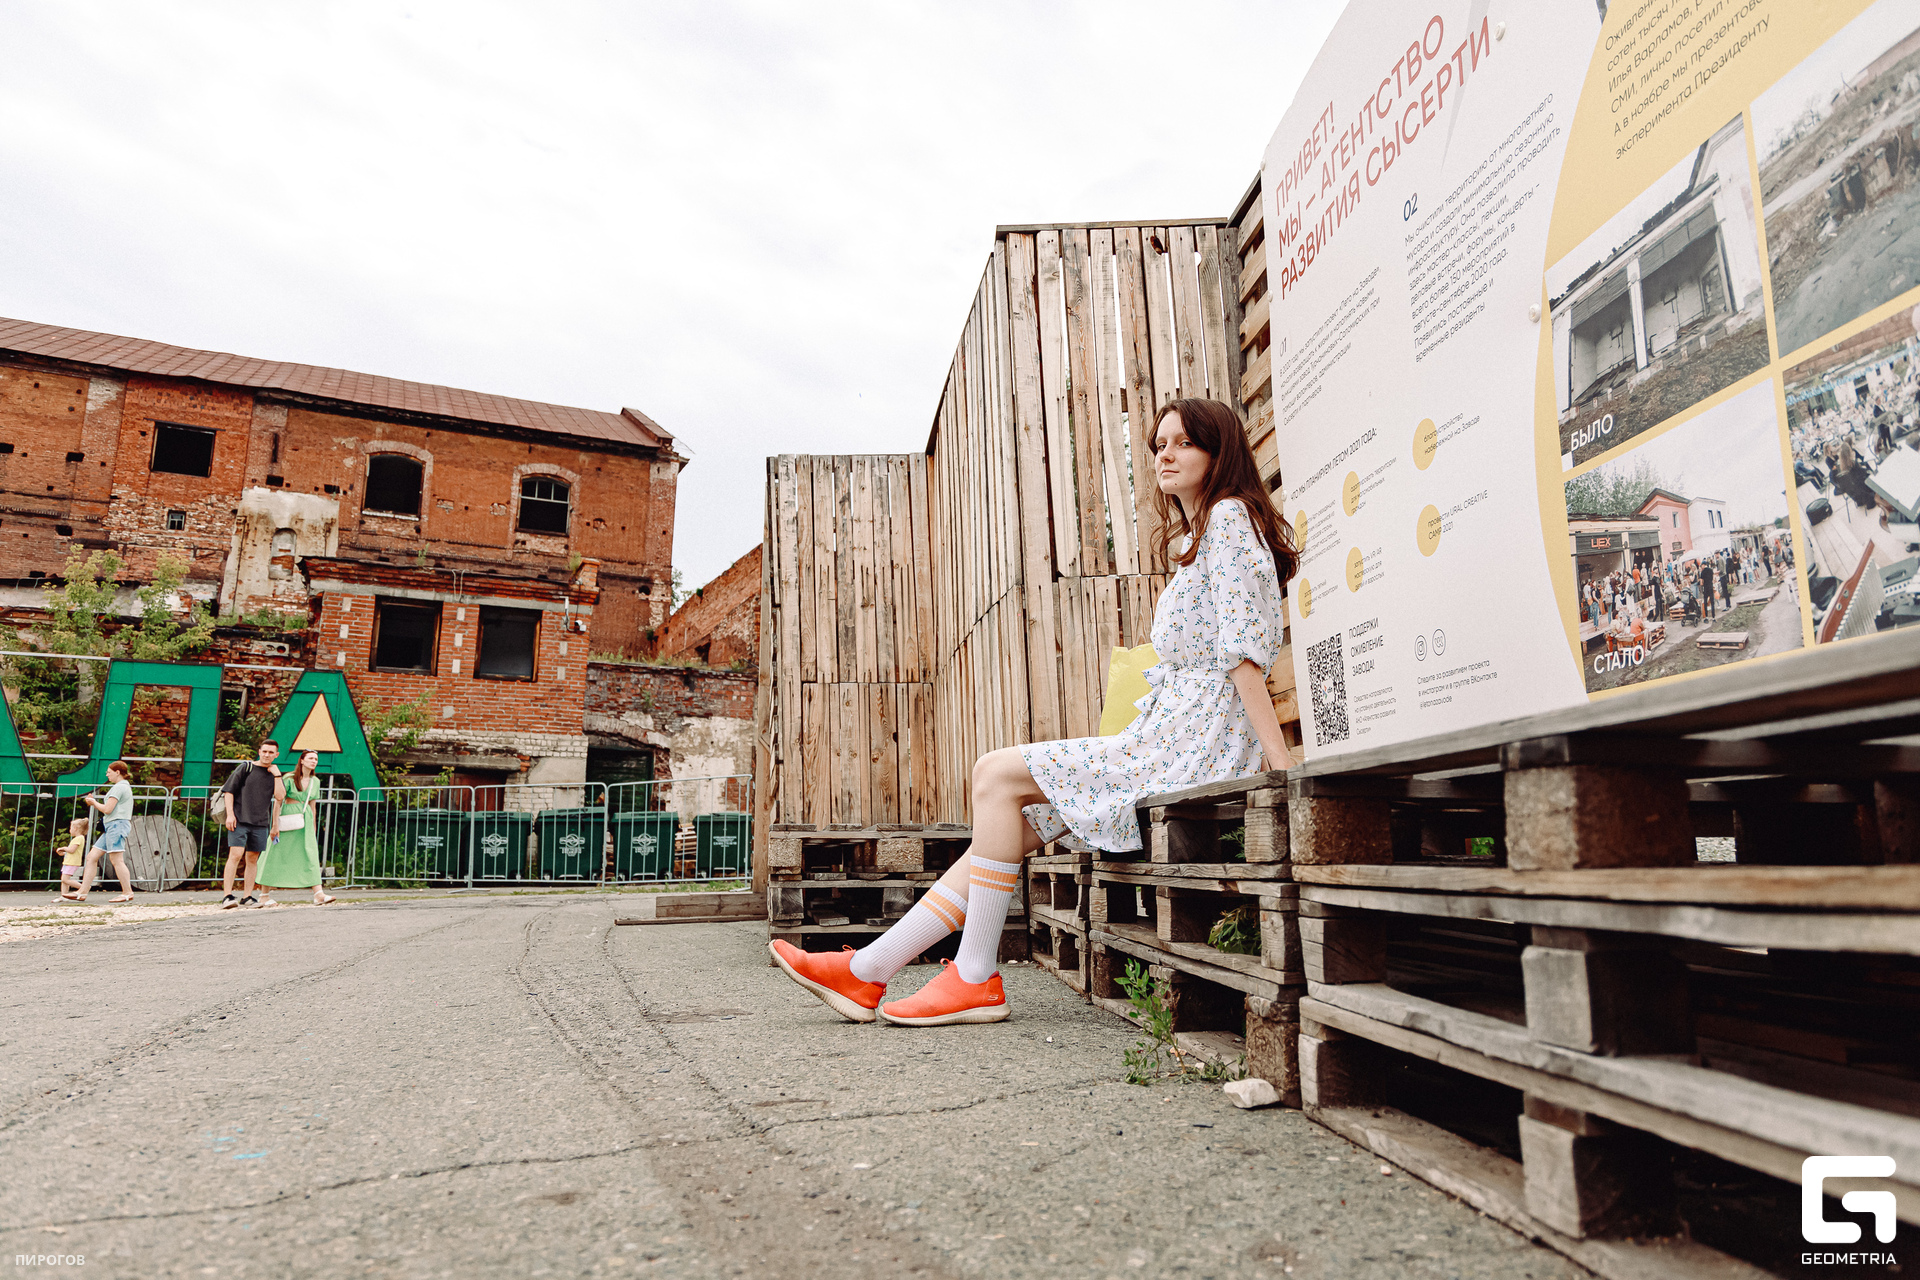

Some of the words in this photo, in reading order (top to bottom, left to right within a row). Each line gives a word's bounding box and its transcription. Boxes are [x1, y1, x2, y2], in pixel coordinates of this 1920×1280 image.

[1605, 0, 1656, 51] Оживлен
[1607, 37, 1636, 72] сотен
[1638, 7, 1669, 40] тысяч
[1609, 65, 1632, 93] Илья
[1634, 6, 1693, 68] Варламов,
[1611, 83, 1638, 113] СМИ,
[1640, 51, 1672, 88] лично
[1675, 0, 1723, 54] посетил
[1614, 123, 1621, 137] А
[1623, 117, 1629, 128] в
[1632, 79, 1669, 121] ноябре
[1672, 62, 1688, 83] мы
[1616, 86, 1692, 160] эксперимента
[1695, 14, 1770, 89] Президенту
[1276, 101, 1335, 217] ПРИВЕТ!
[1279, 201, 1302, 258] МЫ
[1321, 15, 1444, 200] АГЕНТСТВО
[1281, 169, 1361, 300] РАЗВИТИЯ
[1366, 15, 1490, 186] СЫСЕРТИ
[1405, 230, 1414, 247] Мы
[1415, 200, 1443, 236] очистили
[1445, 156, 1487, 210] территорию
[1489, 146, 1497, 163] от
[1498, 89, 1553, 153] многолетнего
[1403, 192, 1418, 222] 02
[1406, 233, 1429, 263] мусора
[1429, 227, 1434, 239] и
[1435, 200, 1462, 235] создали
[1463, 151, 1512, 210] минимальную
[1514, 110, 1554, 160] сезонную
[1407, 220, 1459, 279] инфраструктуру.
[1460, 203, 1475, 227] Она
[1476, 166, 1515, 211] позволила
[1517, 122, 1560, 175] проводить
[1409, 269, 1426, 291] здесь
[1426, 219, 1479, 277] мастер-классы,
[1480, 192, 1508, 227] лекции,
[1410, 275, 1436, 305] деловые
[1437, 248, 1465, 284] встречи,
[1466, 219, 1496, 258] форумы,
[1497, 185, 1533, 229] концерты
[1412, 297, 1428, 319] всего
[1429, 278, 1448, 304] более
[1450, 267, 1460, 286] 150
[1462, 226, 1509, 278] мероприятий
[1510, 221, 1515, 233] в
[1413, 278, 1469, 336] августе-сентябре
[1470, 262, 1487, 285] 2020
[1489, 245, 1508, 270] года.
[1414, 314, 1446, 349] Появились
[1447, 281, 1487, 322] постоянные
[1489, 276, 1493, 288] и
[1416, 328, 1449, 363] временные
[1450, 300, 1485, 337] резиденты
[1280, 337, 1286, 357] 01
[1571, 413, 1614, 451] БЫЛО
[1348, 617, 1378, 638] ПОДДЕРЖИ
[1350, 634, 1383, 657] ОЖИВЛЕНИЕ
[1352, 658, 1374, 677] ЗАВОДА!
[1594, 645, 1645, 674] СТАЛО
